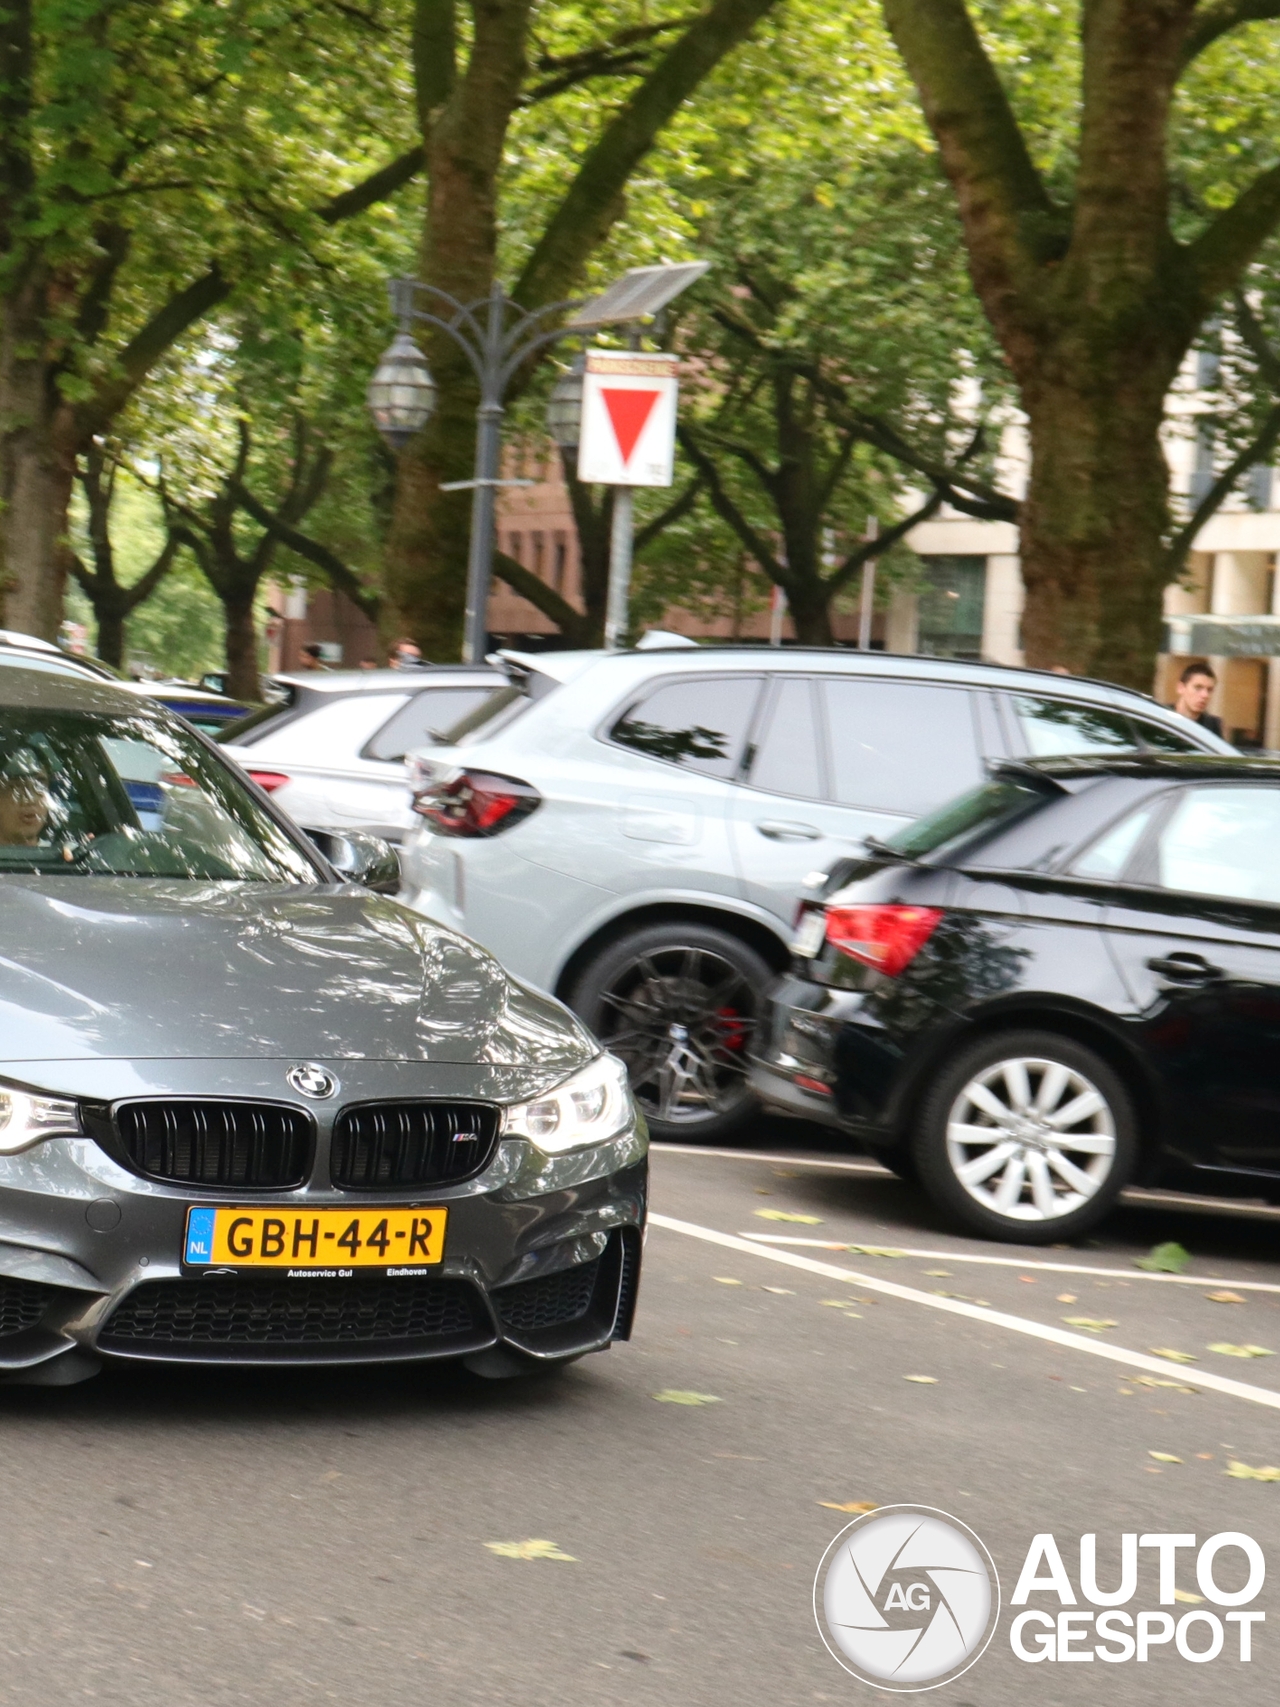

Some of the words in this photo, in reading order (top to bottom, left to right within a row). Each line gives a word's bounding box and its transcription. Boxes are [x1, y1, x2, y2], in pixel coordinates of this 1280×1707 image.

[227, 1217, 433, 1258] GBH-44-R
[190, 1242, 208, 1255] NL
[287, 1269, 337, 1278] Autoservice
[338, 1269, 353, 1278] Gul
[386, 1268, 427, 1277] Eindhoven
